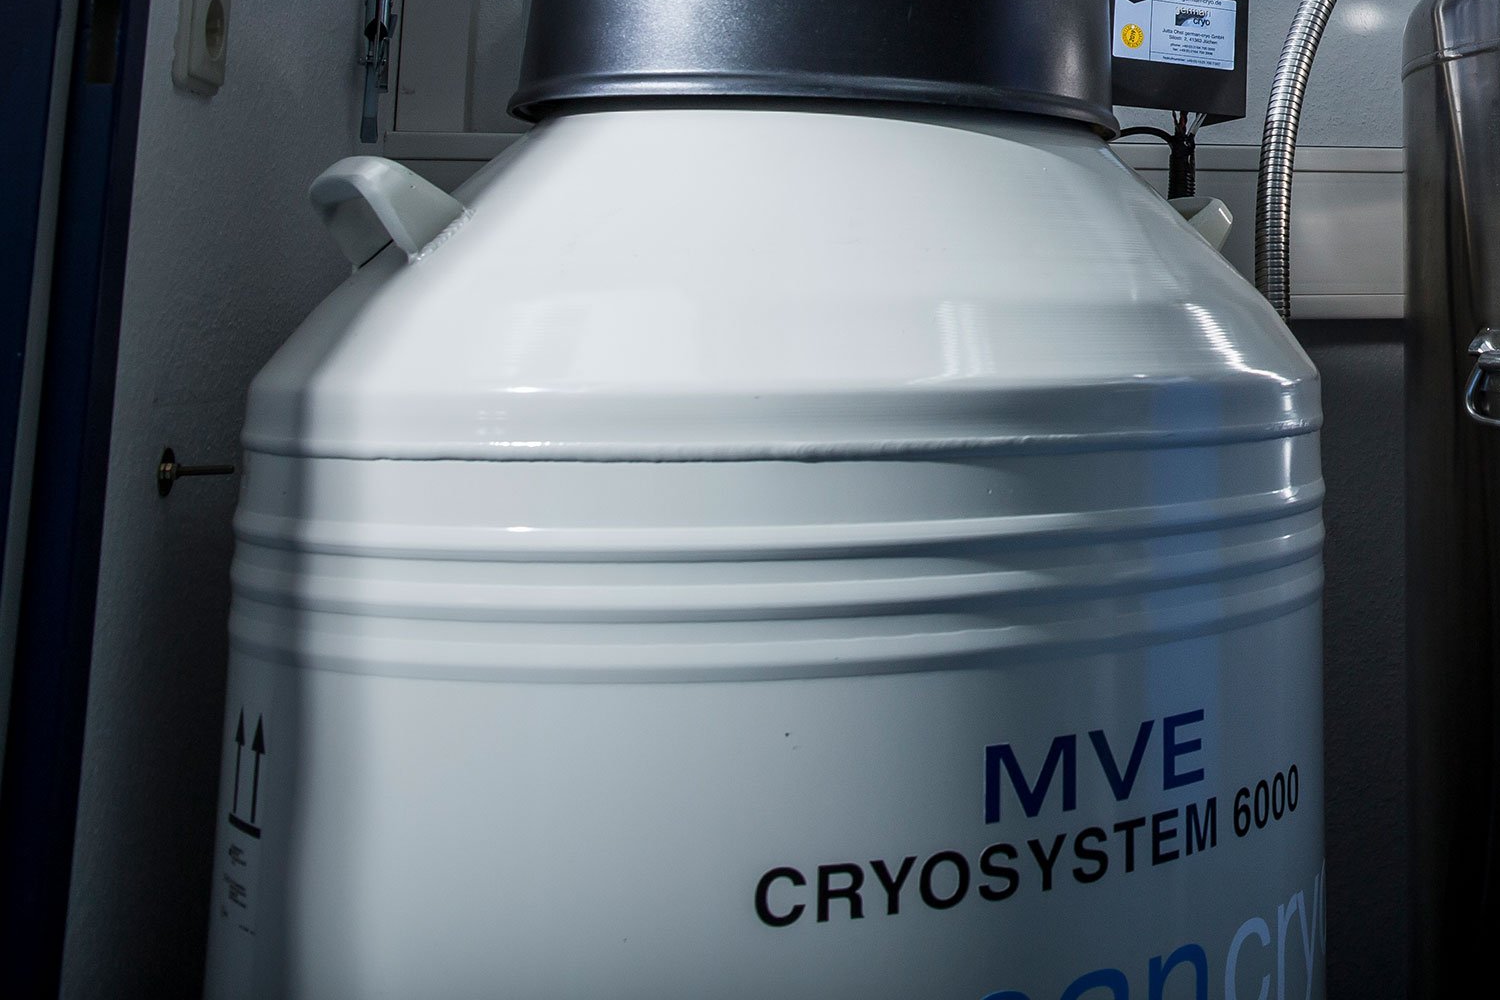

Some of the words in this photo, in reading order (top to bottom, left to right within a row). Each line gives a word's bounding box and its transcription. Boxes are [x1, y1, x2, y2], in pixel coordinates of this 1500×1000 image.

[1192, 17, 1211, 28] cryo
[985, 709, 1205, 825] MVE
[754, 796, 1218, 927] CRYOSYSTEM
[1233, 763, 1300, 838] 6000
